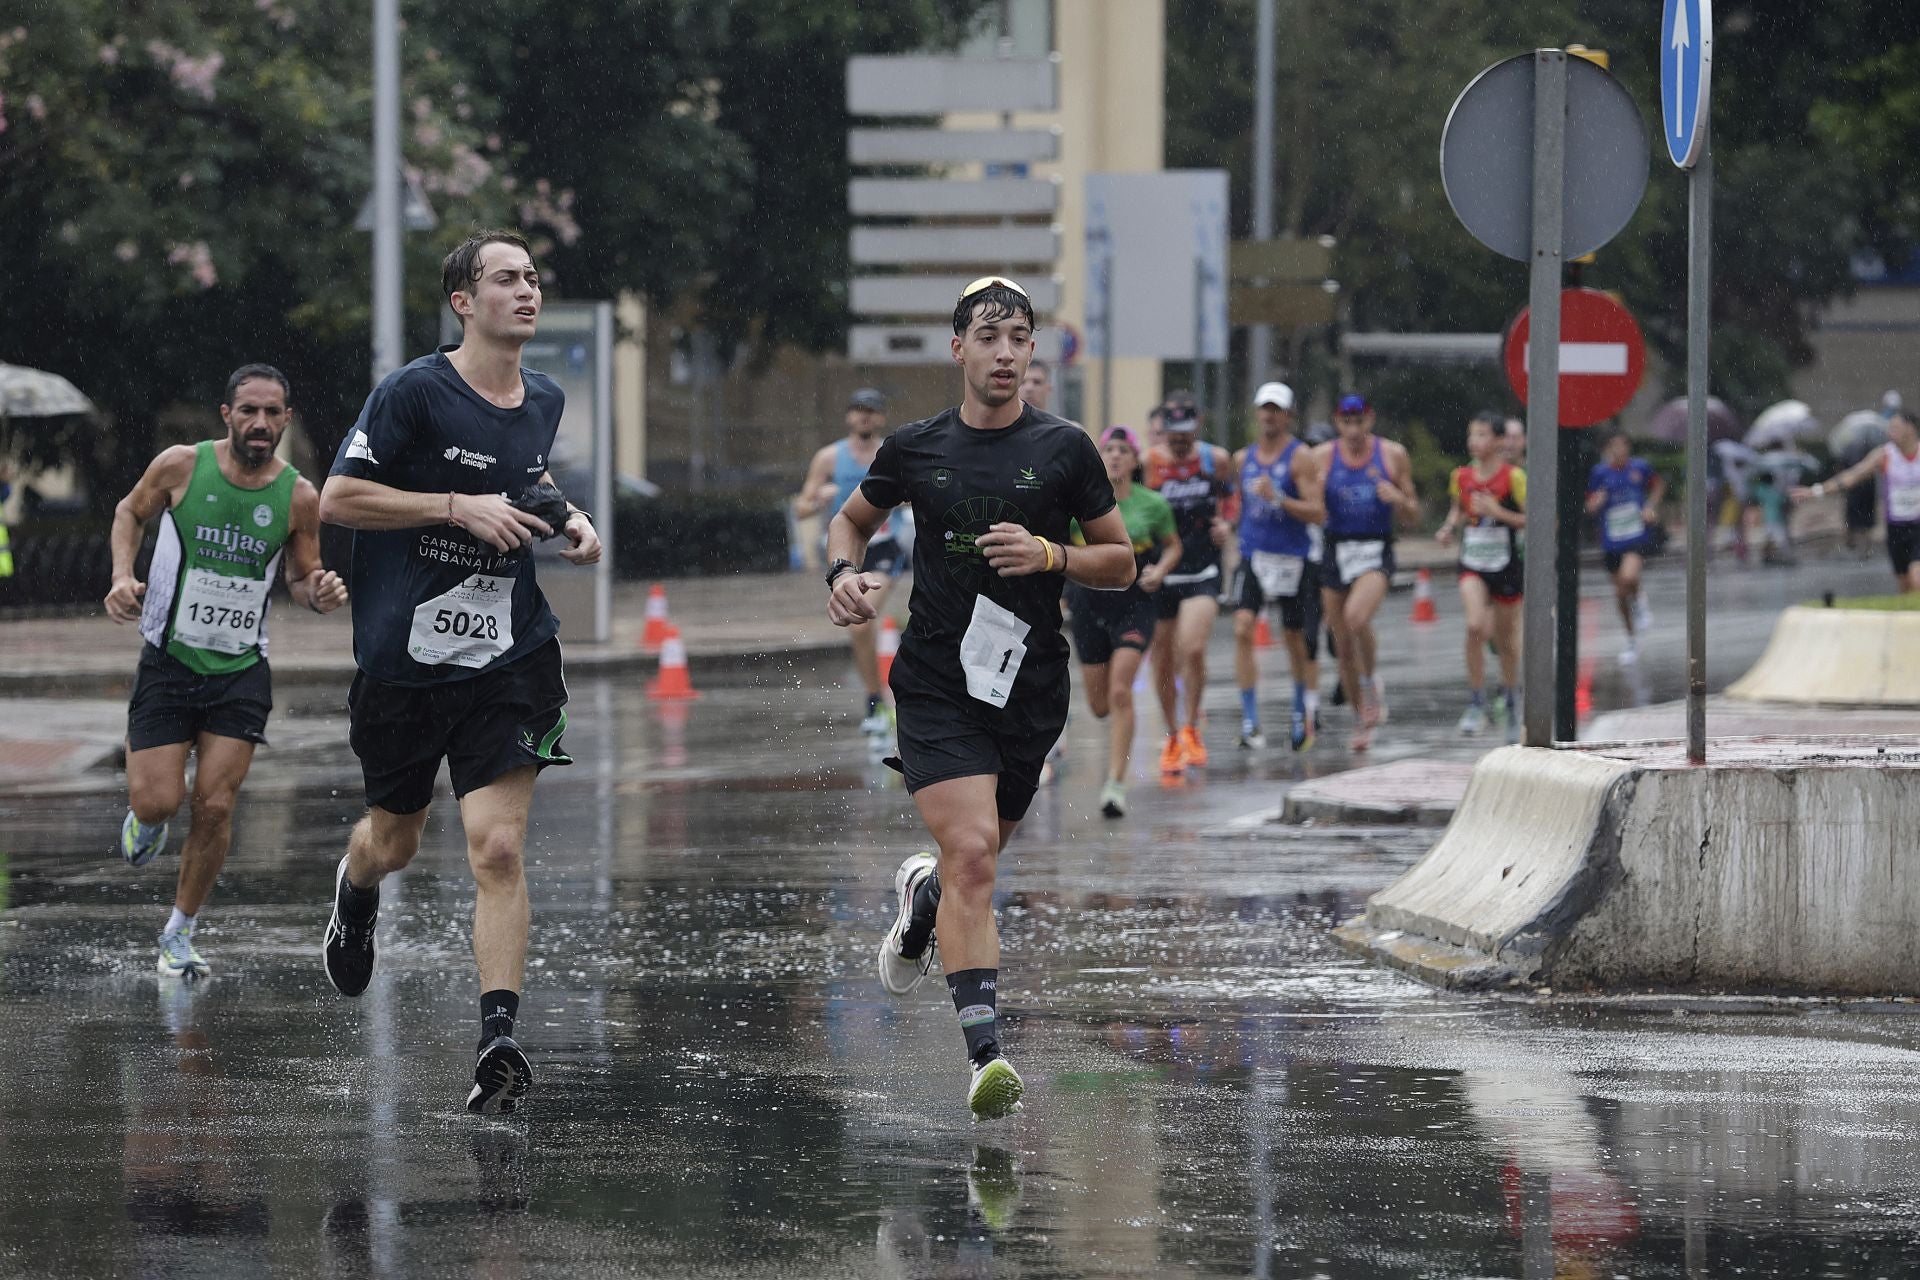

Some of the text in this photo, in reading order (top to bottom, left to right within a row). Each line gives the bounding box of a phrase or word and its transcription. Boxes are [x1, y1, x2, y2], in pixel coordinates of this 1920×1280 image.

[460, 456, 488, 471] Unicaja
[461, 449, 497, 464] Fundación
[194, 522, 268, 555] mijas
[419, 545, 482, 568] URBANA
[189, 602, 256, 630] 13786
[433, 608, 499, 641] 5028
[999, 648, 1013, 674] 1
